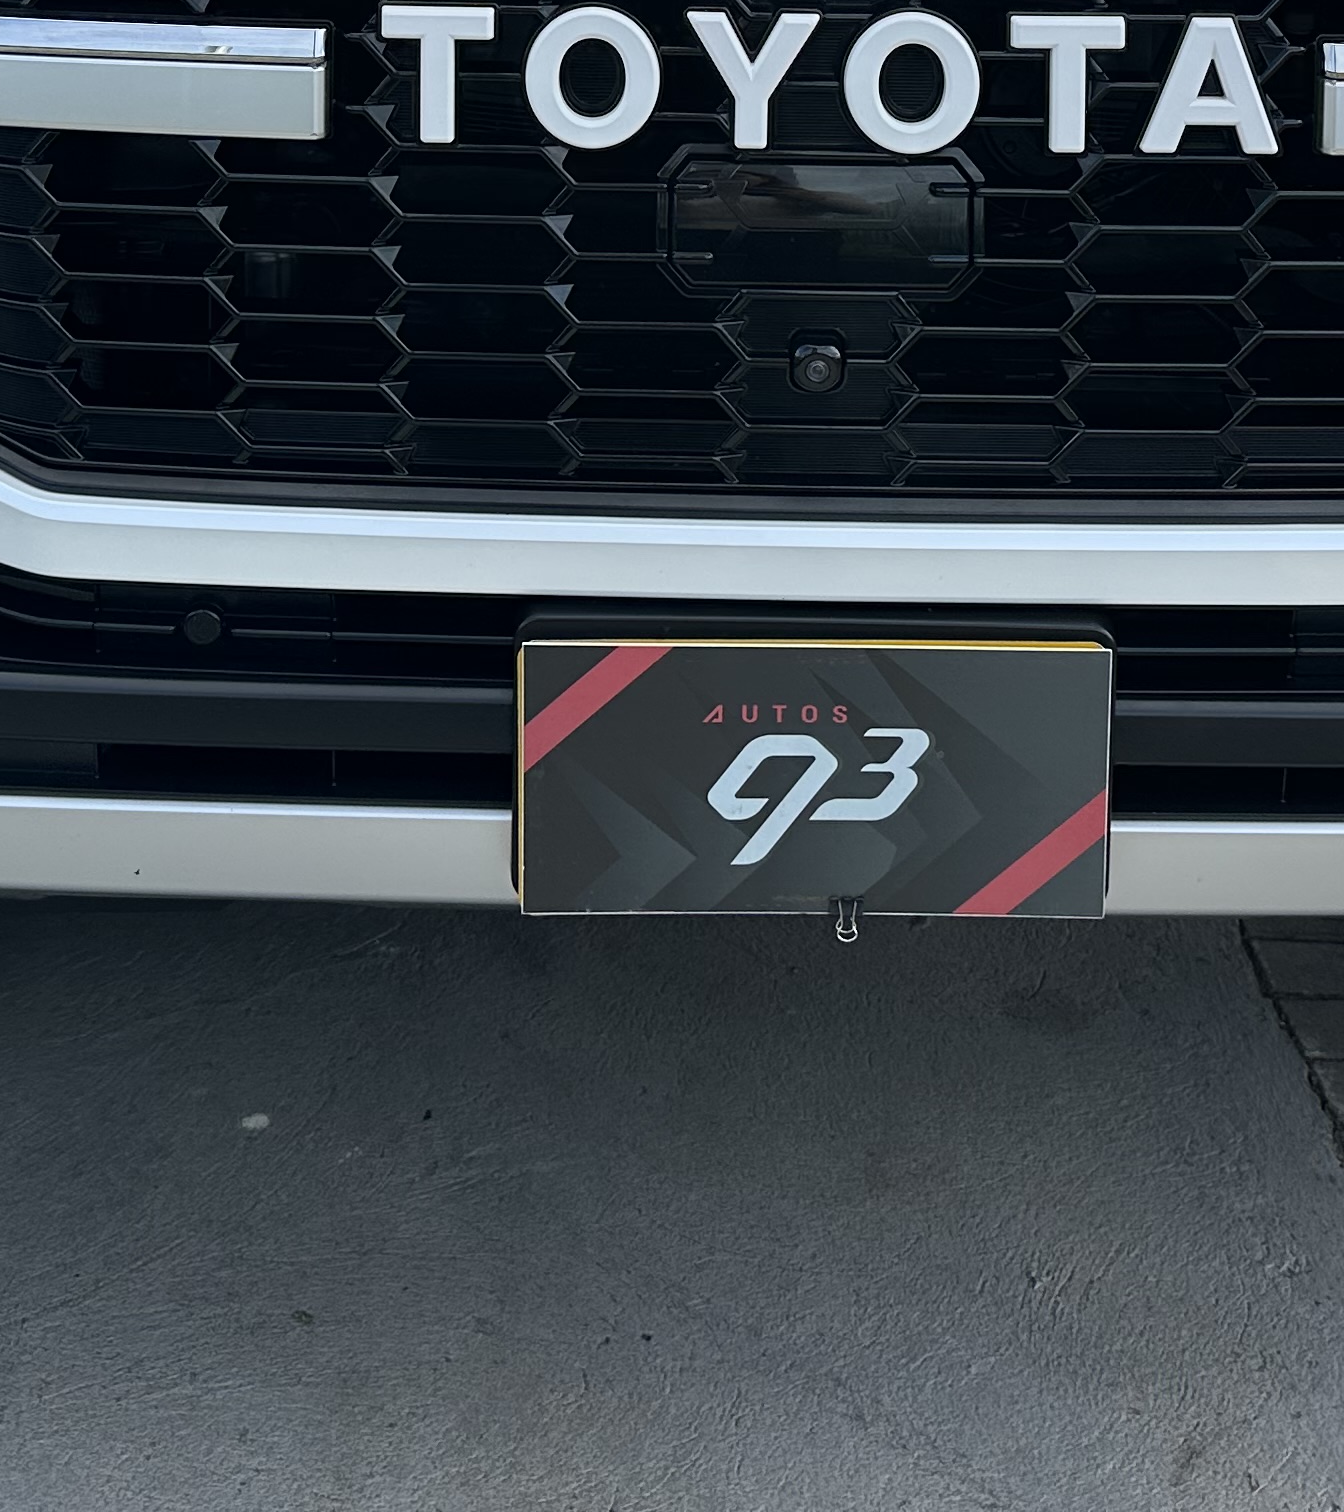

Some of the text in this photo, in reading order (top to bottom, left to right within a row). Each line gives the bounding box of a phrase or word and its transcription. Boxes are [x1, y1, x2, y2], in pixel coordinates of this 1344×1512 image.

[381, 5, 1279, 154] TOYOTA
[702, 704, 849, 724] AUTOS
[706, 727, 931, 866] 93
